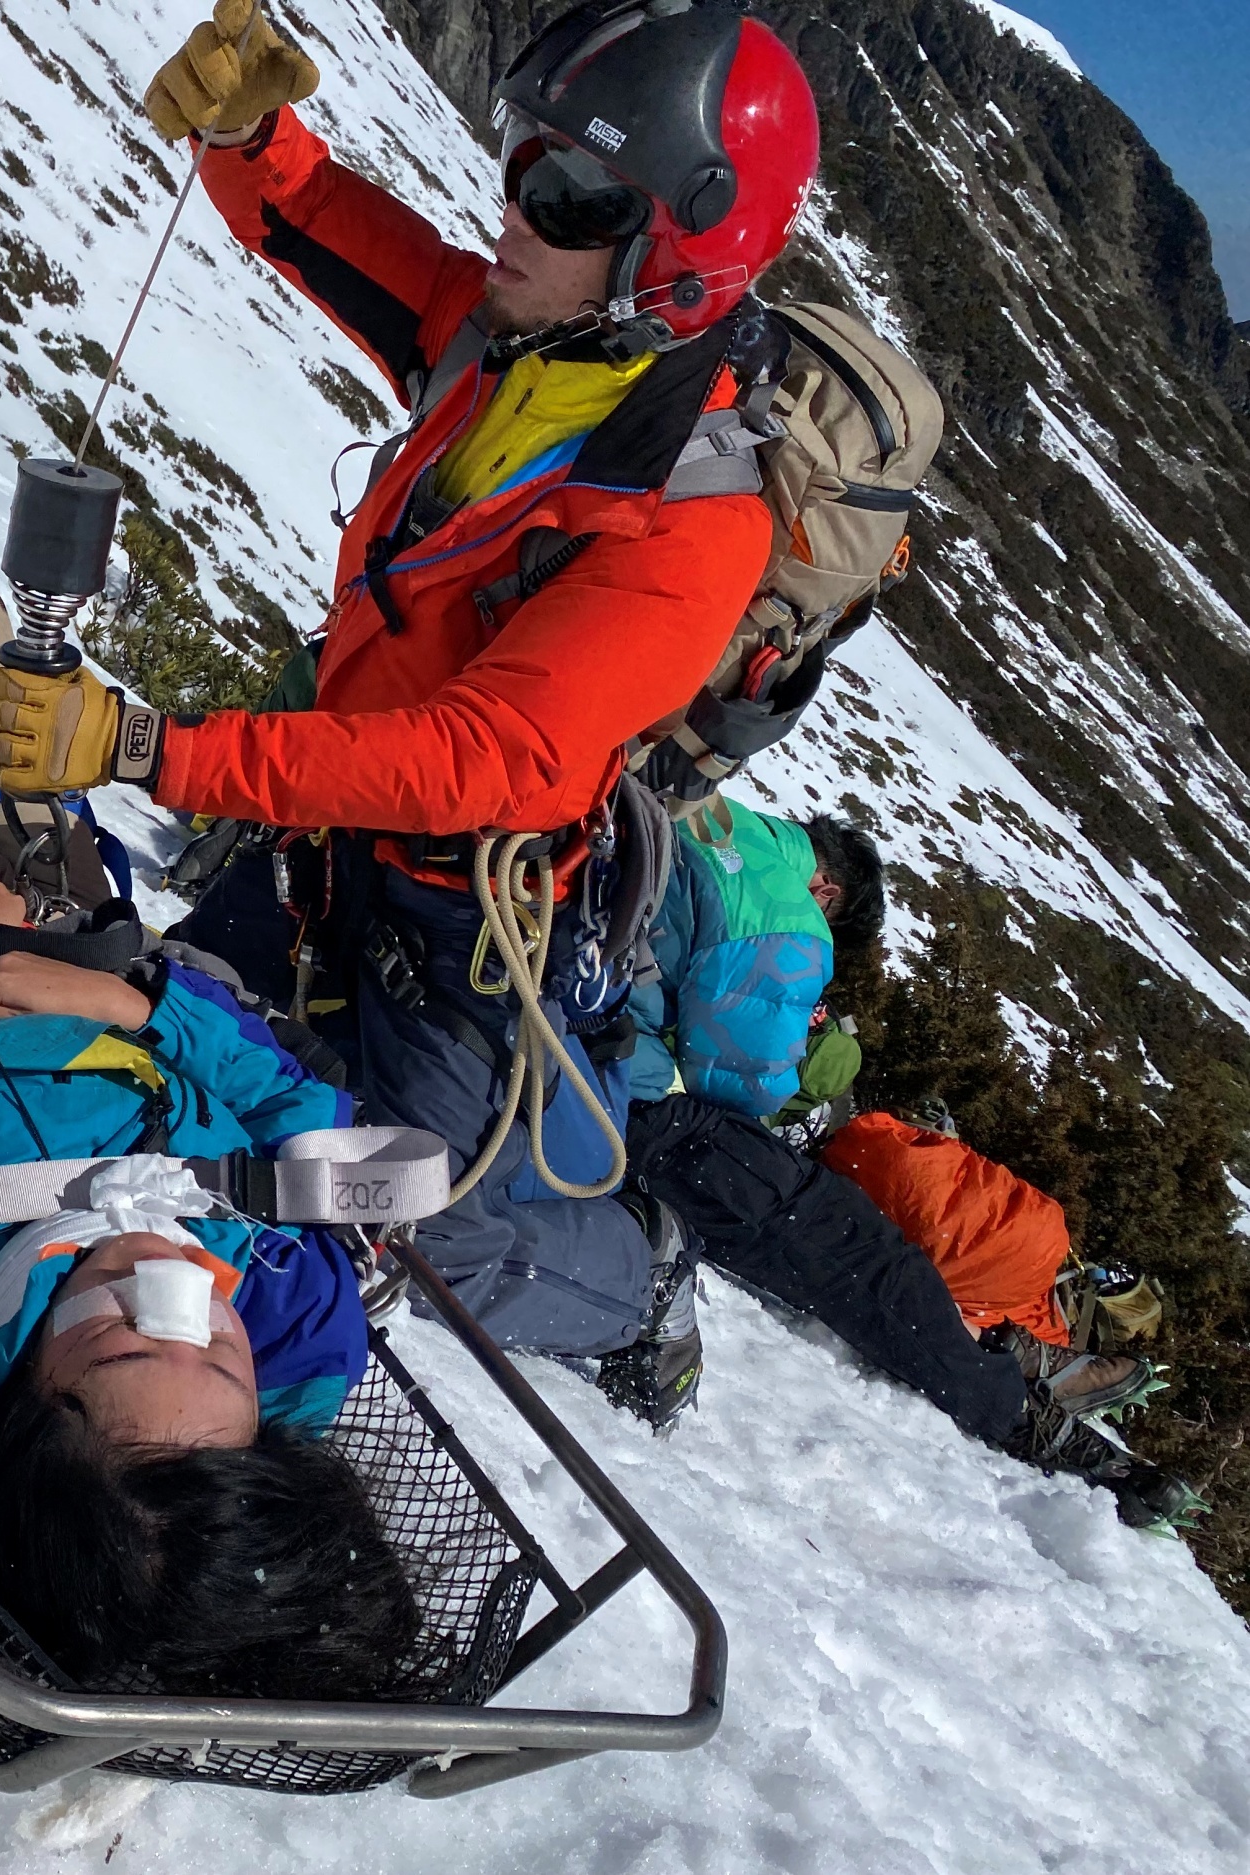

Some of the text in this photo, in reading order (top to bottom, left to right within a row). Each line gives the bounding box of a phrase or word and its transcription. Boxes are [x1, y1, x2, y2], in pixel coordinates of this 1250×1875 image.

[589, 119, 624, 147] MSA
[129, 714, 150, 757] PETZL
[335, 1180, 393, 1210] 202
